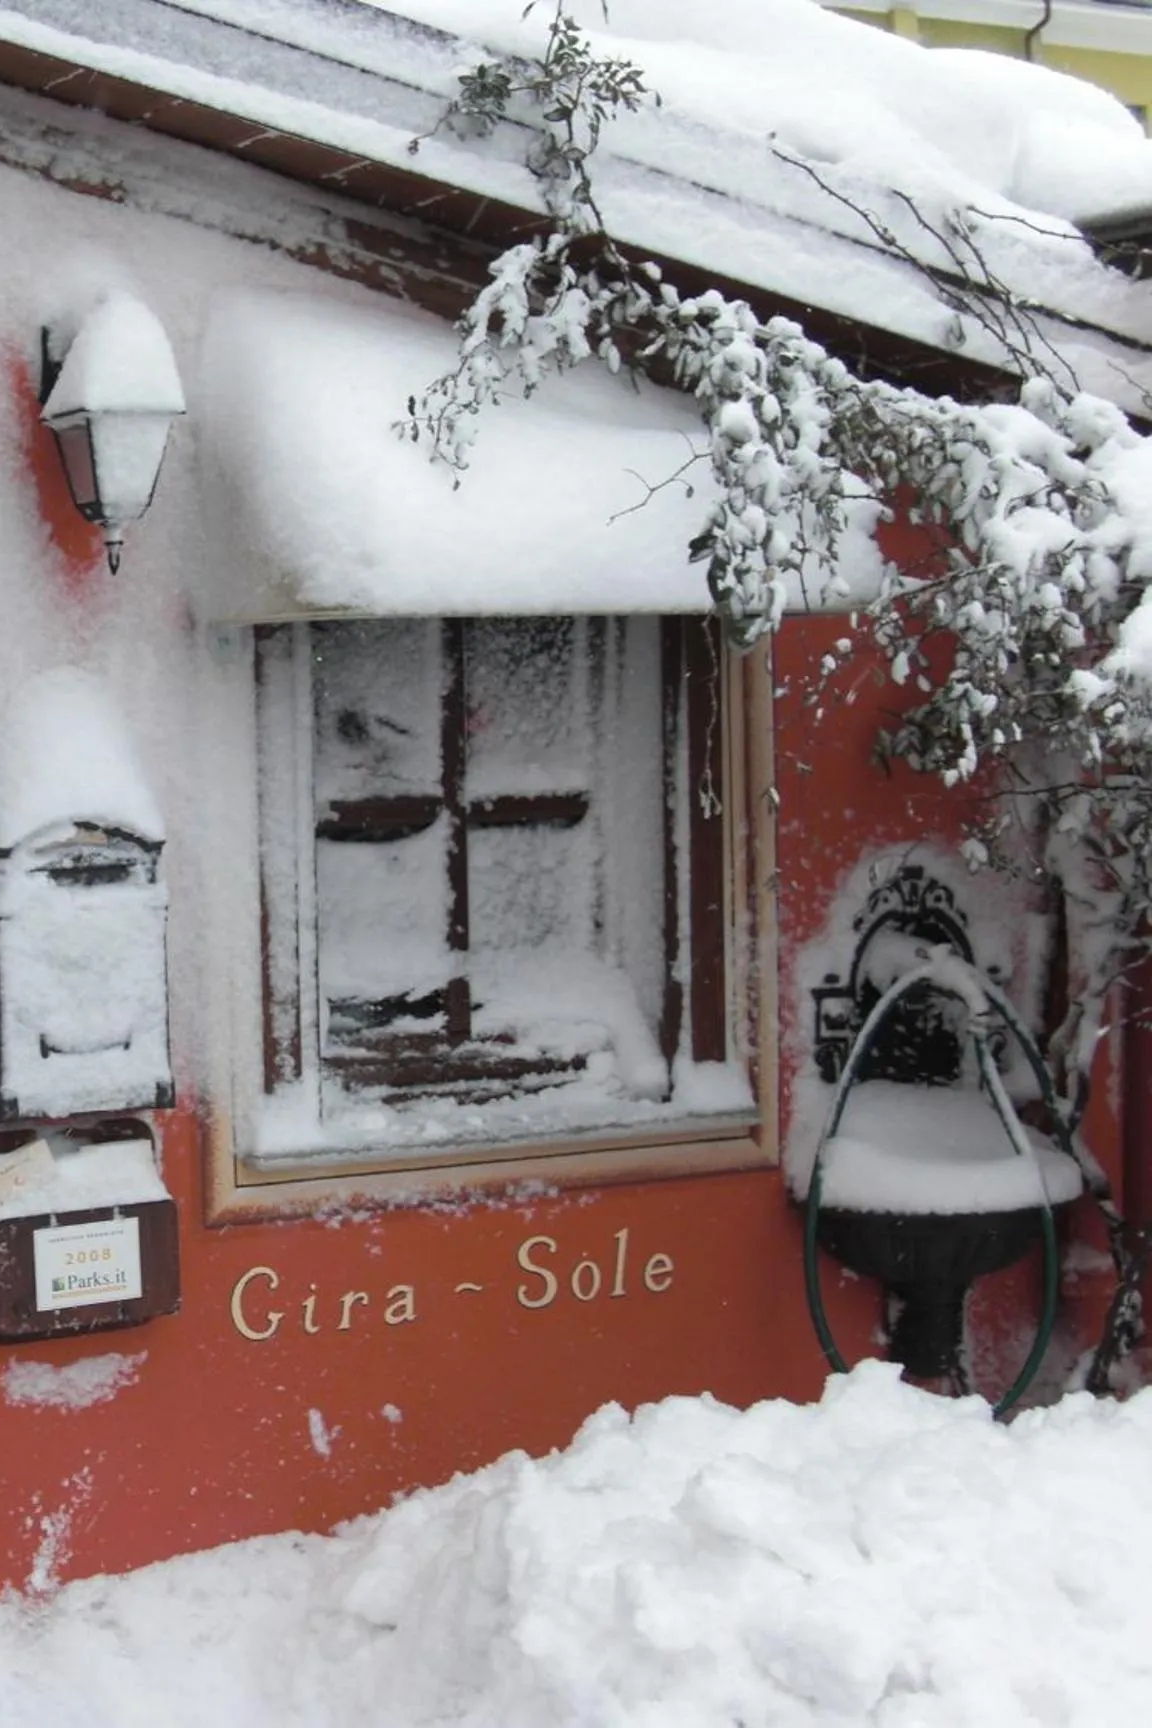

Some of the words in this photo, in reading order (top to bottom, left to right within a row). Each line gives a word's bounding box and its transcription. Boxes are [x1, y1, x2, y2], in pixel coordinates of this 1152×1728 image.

[65, 1248, 112, 1265] 2008
[67, 1269, 128, 1290] Parks.it
[230, 1265, 418, 1341] Gira
[516, 1227, 674, 1309] Sole
